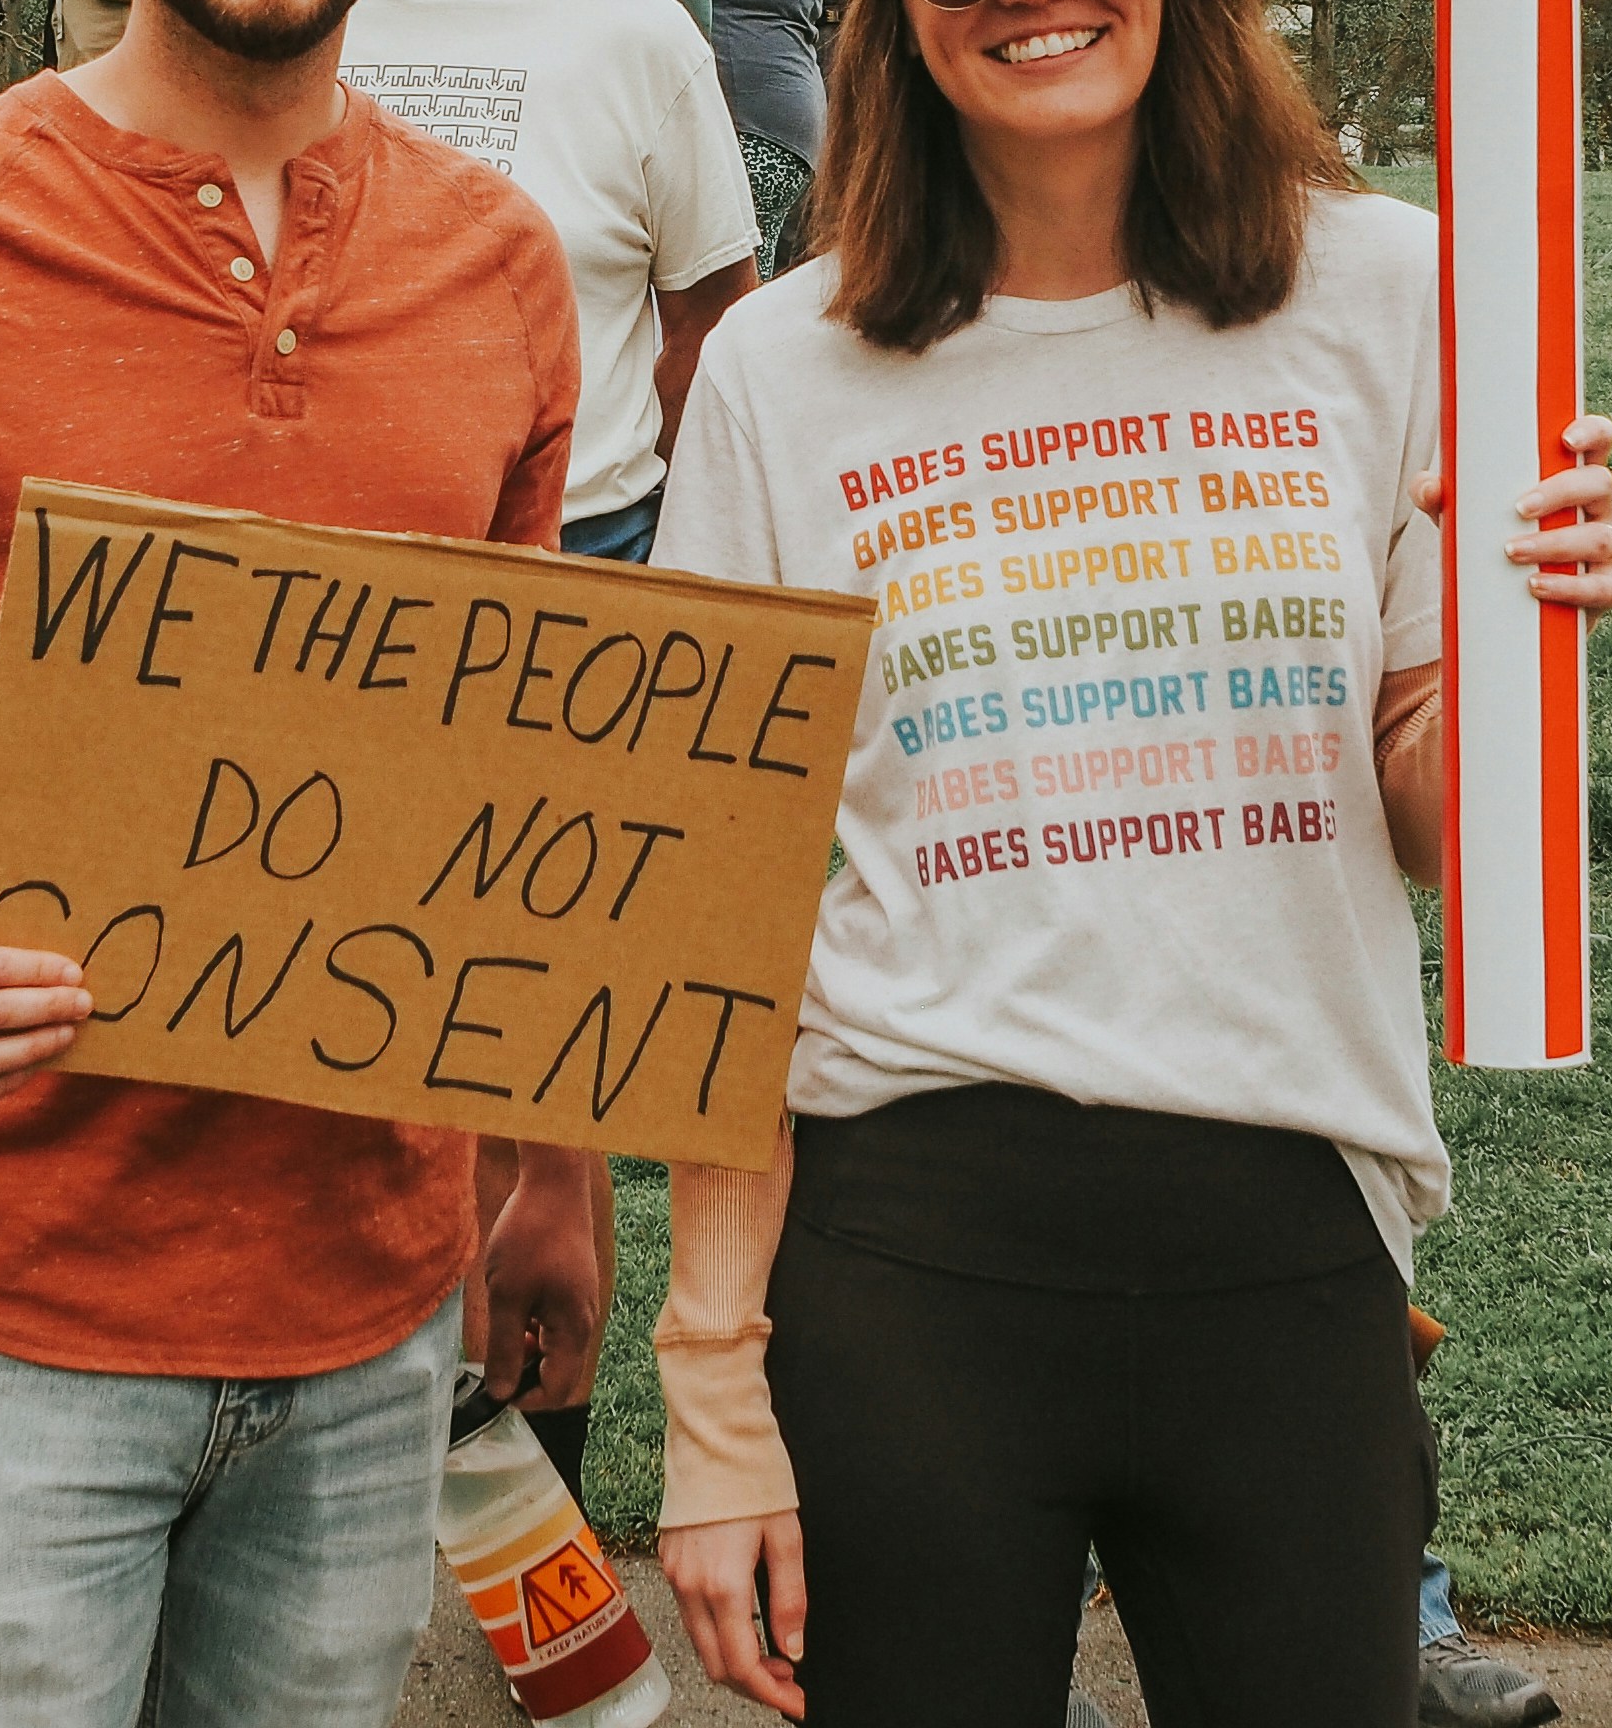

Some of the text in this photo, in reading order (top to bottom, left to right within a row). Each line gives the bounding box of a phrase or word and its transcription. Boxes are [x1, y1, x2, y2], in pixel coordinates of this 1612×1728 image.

[839, 409, 1319, 512] BABES SUPPORT BABES
[853, 470, 1330, 570] BABES SUPPORT BABES
[1000, 539, 1191, 594] SUPPORT
[1210, 532, 1341, 575] BABES
[32, 507, 837, 777] WE THE PEOPLE
[881, 597, 1346, 695] BABES SUPPORT BABES
[1021, 672, 1209, 728] SUPPORT
[1228, 665, 1347, 709] BABES
[916, 759, 1019, 821] BABES
[1031, 738, 1217, 797] SUPPORT
[183, 758, 686, 922] DO NOT
[916, 827, 1029, 887] BABES
[1042, 808, 1225, 866] SUPPORT
